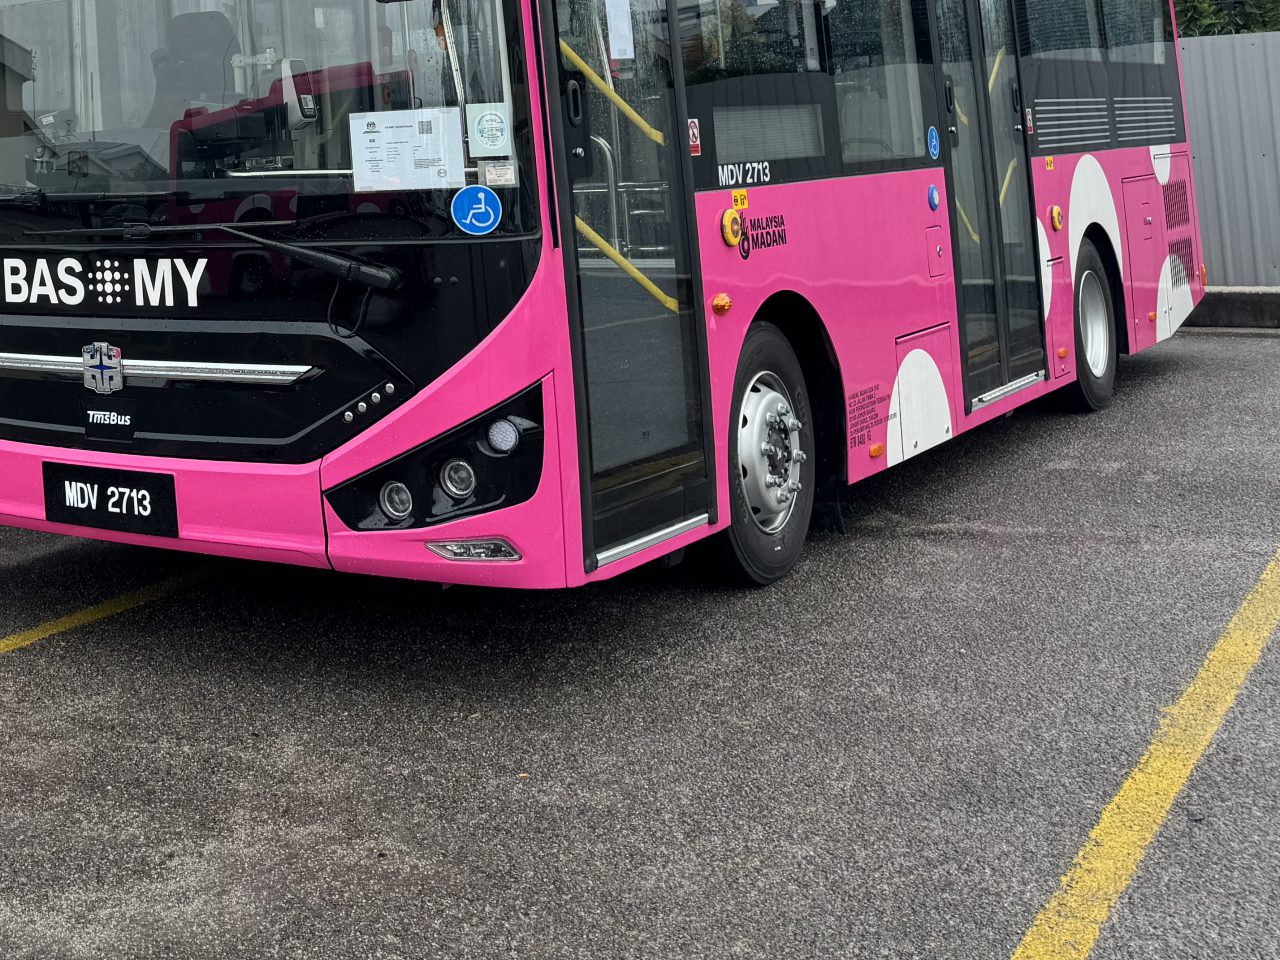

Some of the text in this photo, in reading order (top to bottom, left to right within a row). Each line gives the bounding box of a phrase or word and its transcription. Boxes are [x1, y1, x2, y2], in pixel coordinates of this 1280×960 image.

[718, 161, 771, 186] MDV 2713
[750, 215, 785, 232] MALAYSIA
[751, 228, 787, 250] MADANI
[3, 257, 208, 307] BAS MY
[86, 410, 131, 425] TmsBus
[64, 480, 151, 517] MDV 2713
